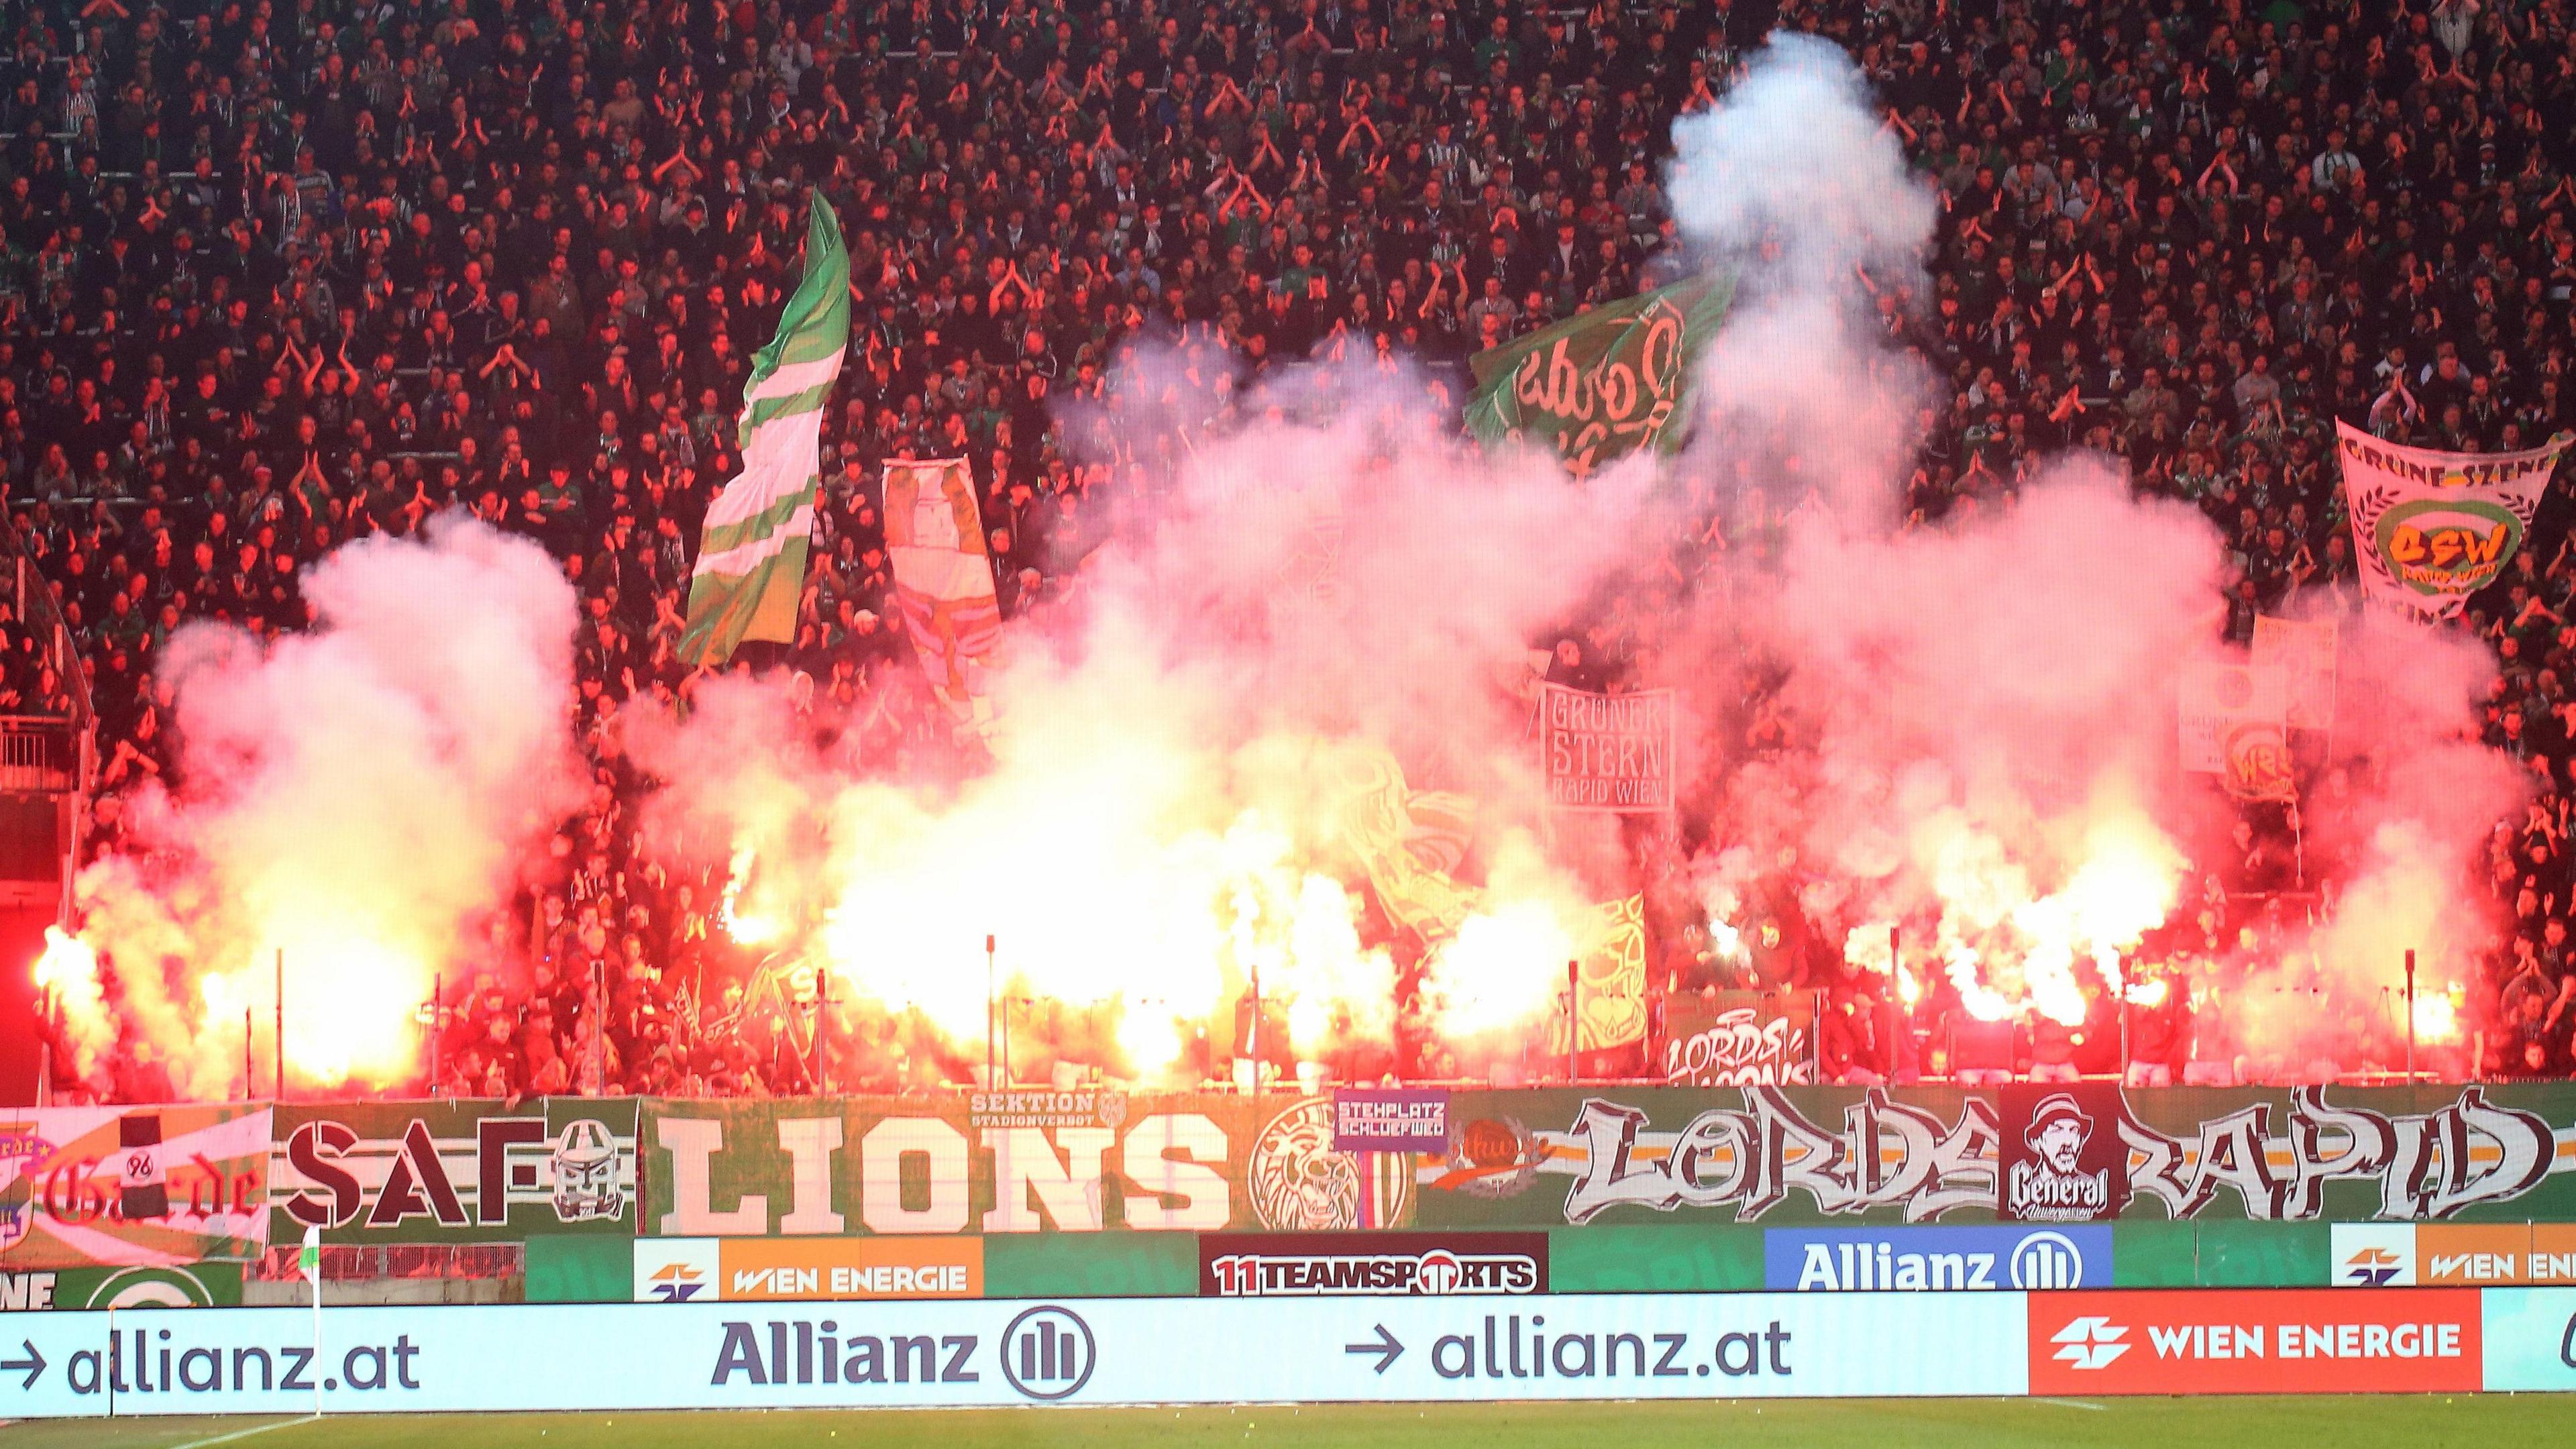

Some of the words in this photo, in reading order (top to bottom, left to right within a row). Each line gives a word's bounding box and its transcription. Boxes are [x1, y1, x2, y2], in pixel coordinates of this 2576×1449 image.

[1552, 729, 1662, 778] STERN
[1552, 777, 1609, 804] RAPID
[1615, 778, 1662, 804] WIEN
[971, 1091, 1095, 1113] SEKTION
[971, 1114, 1095, 1127] STADIONVERBOT
[1338, 1102, 1446, 1118] STEHPLATZ
[126, 1152, 154, 1181] 96
[657, 1114, 1230, 1234] LIONS
[2008, 1158, 2108, 1219] General
[733, 1265, 819, 1294] WIEN
[830, 1265, 967, 1293] ENERGIE
[1799, 1241, 1997, 1289] Allianz
[2430, 1253, 2515, 1279] WIEN
[2527, 1252, 2576, 1279] EN
[711, 1320, 979, 1385] Allianz
[1431, 1314, 1792, 1379] allianz.at
[2148, 1323, 2266, 1360] WIEN
[2277, 1322, 2462, 1359] ENERGIE
[68, 1329, 420, 1395] allianz.at
